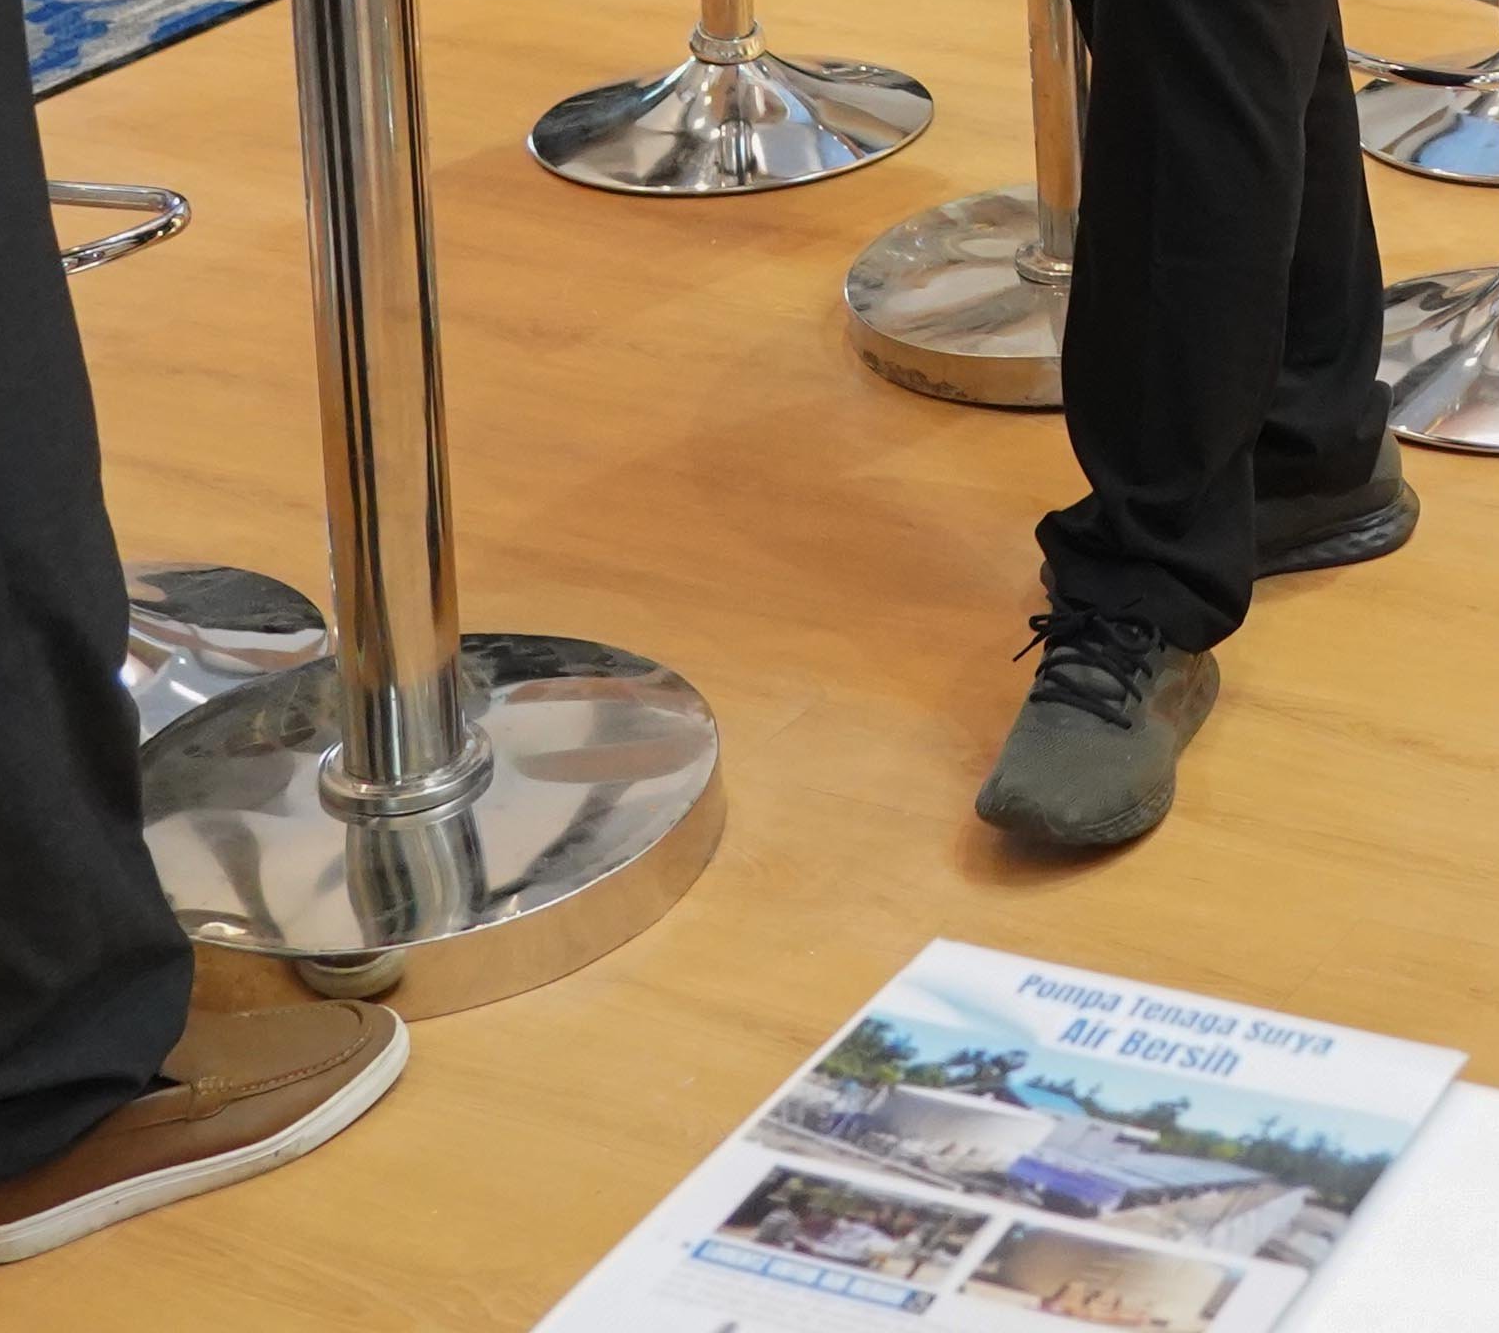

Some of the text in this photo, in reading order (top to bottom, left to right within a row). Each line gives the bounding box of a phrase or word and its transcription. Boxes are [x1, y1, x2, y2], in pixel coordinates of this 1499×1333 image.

[1017, 972, 1335, 1056] Pompa Tenaga Surya
[1058, 1017, 1241, 1078] Air Bersih
